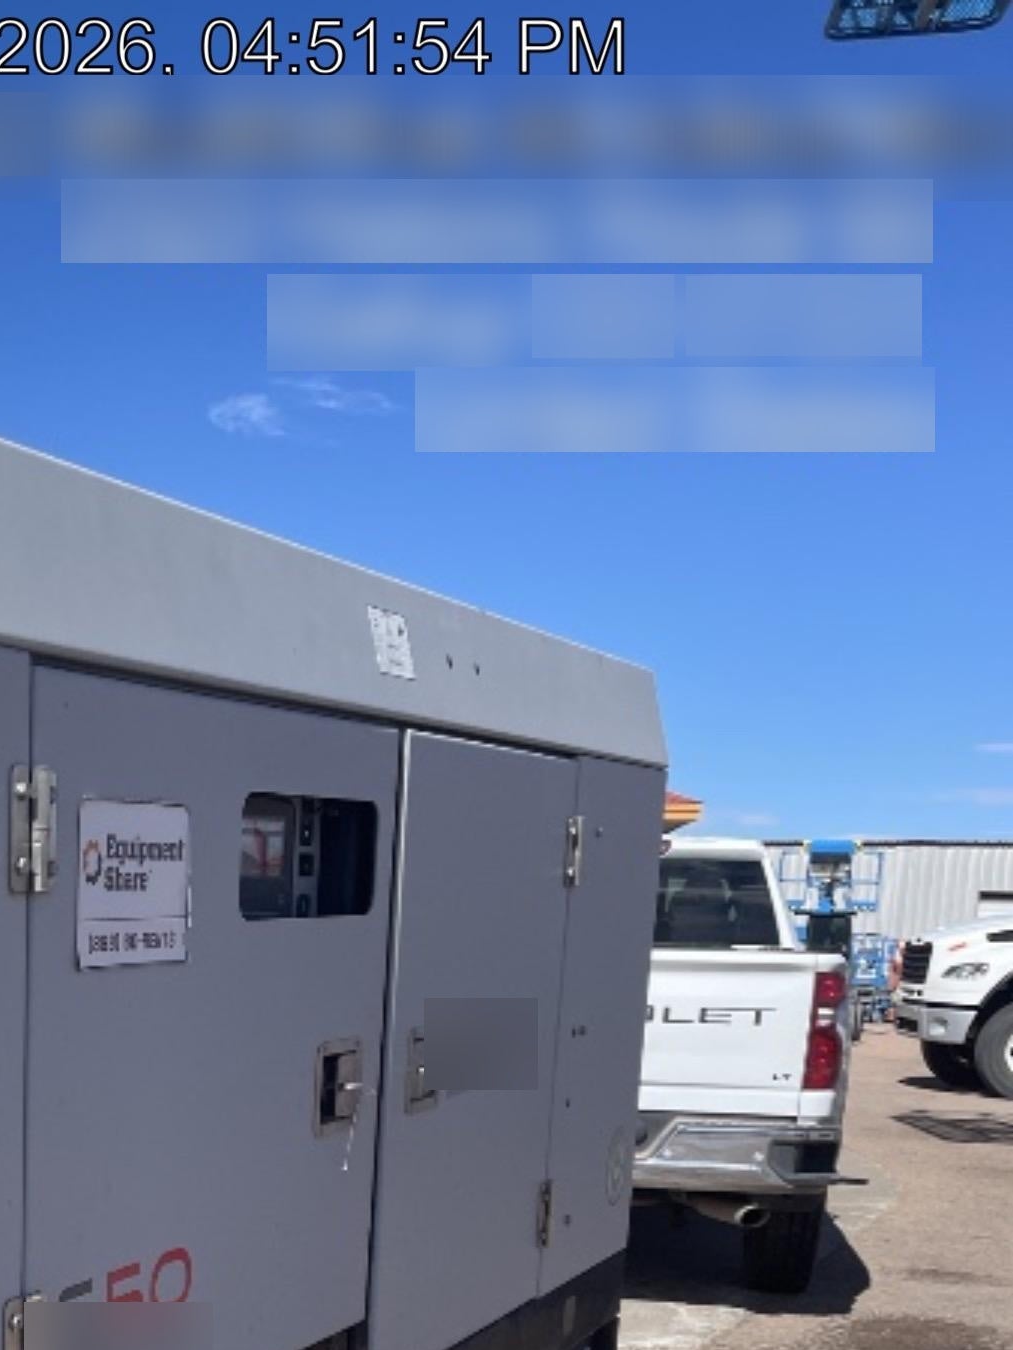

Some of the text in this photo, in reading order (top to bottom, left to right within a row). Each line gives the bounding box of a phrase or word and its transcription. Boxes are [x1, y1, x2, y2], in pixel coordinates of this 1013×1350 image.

[106, 833, 185, 867] Equipment
[104, 866, 148, 892] Share
[772, 1073, 792, 1081] LT
[59, 1247, 192, 1303] 50
